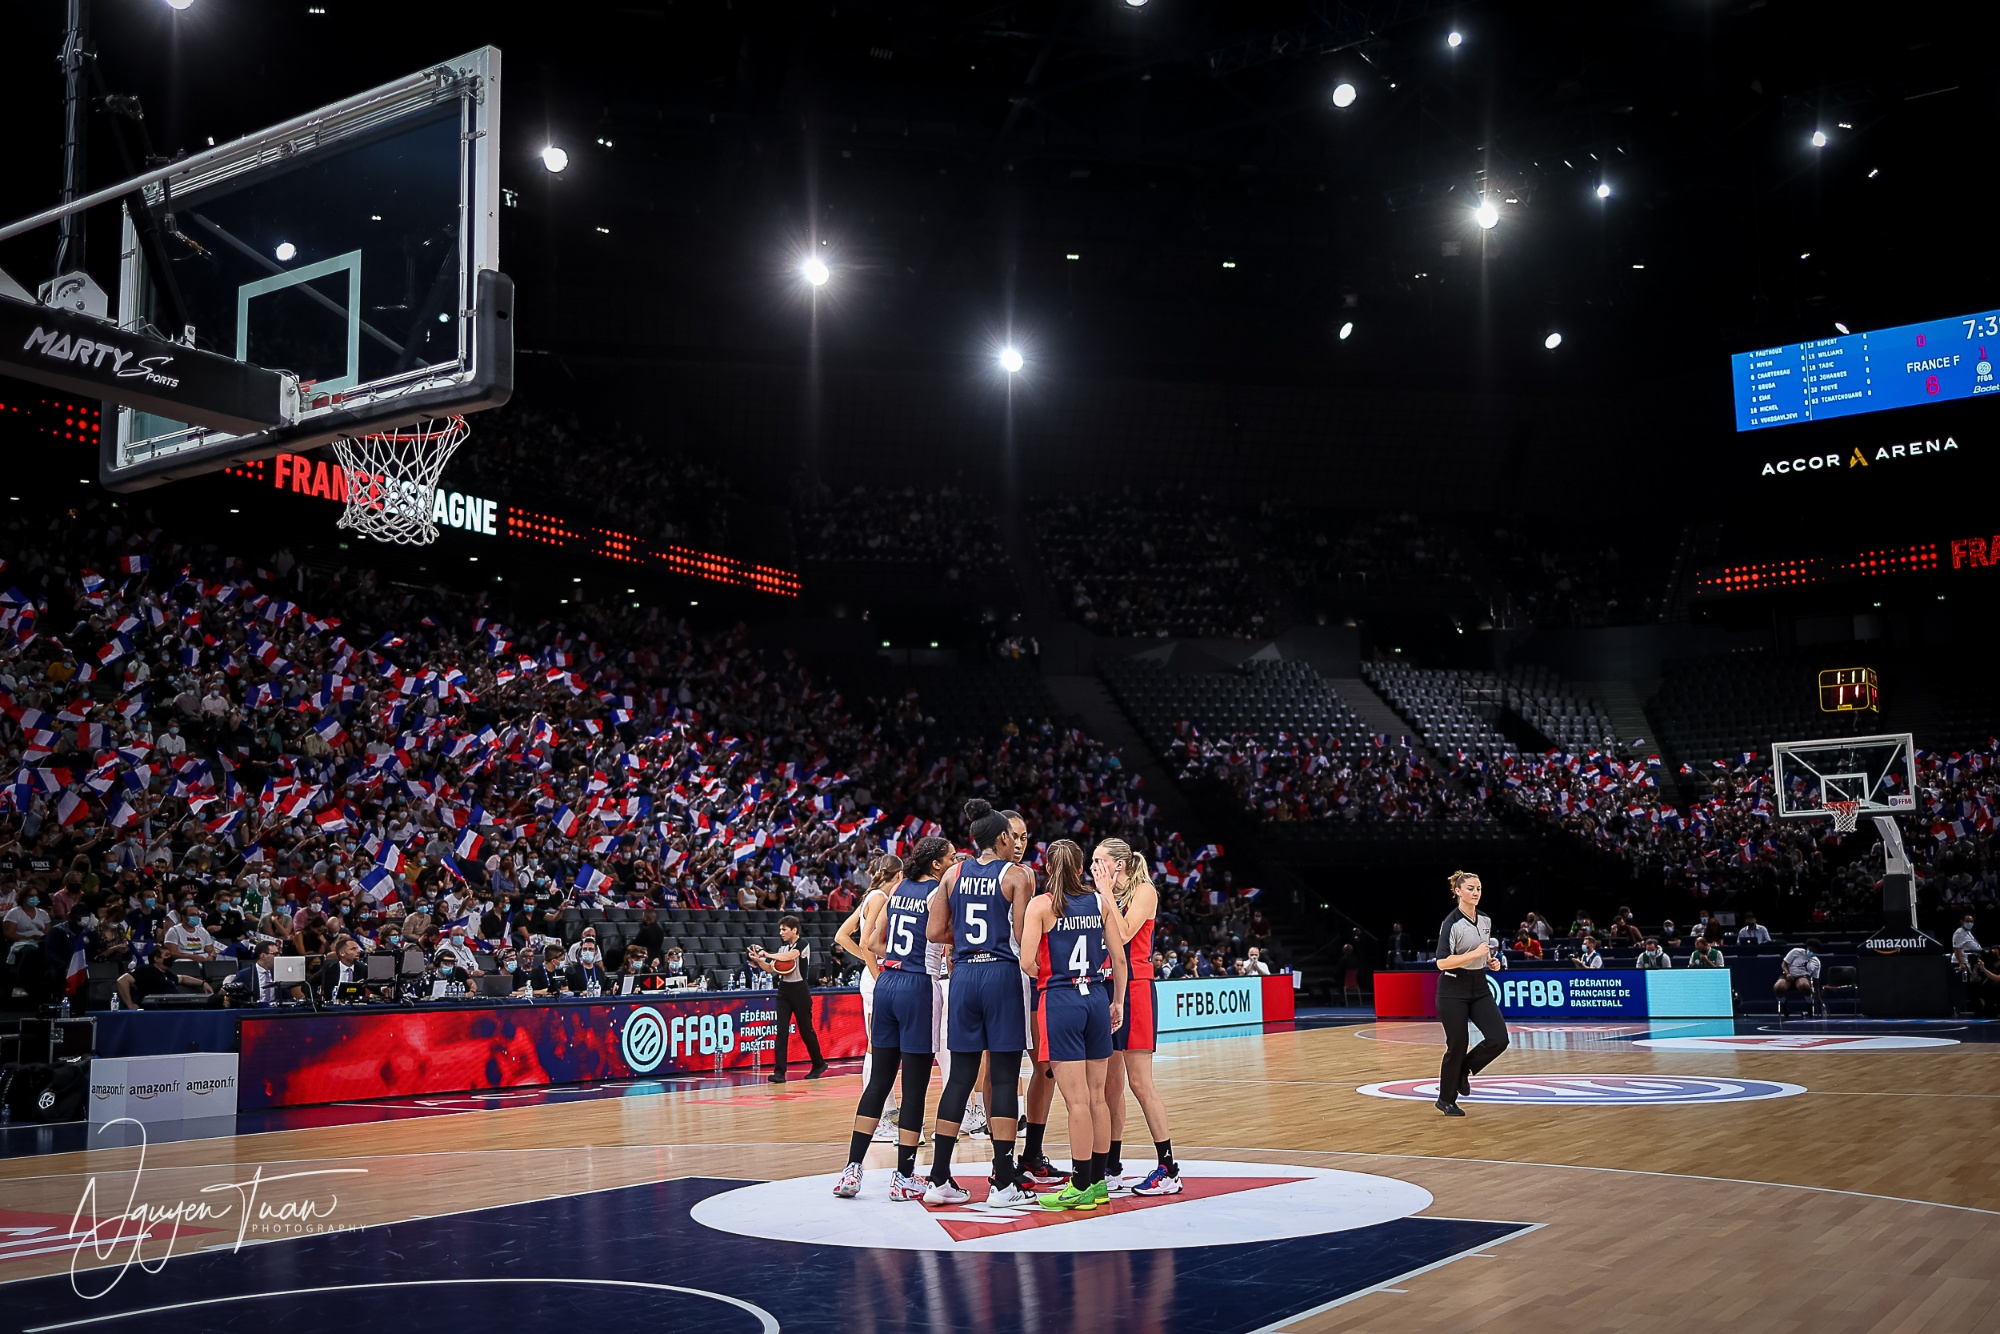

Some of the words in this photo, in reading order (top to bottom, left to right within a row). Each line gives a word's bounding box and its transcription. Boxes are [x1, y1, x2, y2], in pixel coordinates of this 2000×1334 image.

[1916, 334, 1926, 348] 0
[1962, 316, 2000, 340] 7:3
[1817, 338, 1837, 347] RUPERT
[23, 326, 134, 372] MARTY
[117, 356, 180, 388] SPORTS
[1756, 348, 1782, 357] FAUTHOUX
[1818, 348, 1843, 358] WILLIAMS
[1979, 346, 1987, 360] 1
[1907, 357, 1950, 373] FRANCE
[1953, 355, 1960, 366] F
[1757, 369, 1790, 379] CHARTEREAU
[1820, 370, 1847, 380] JOHANNES
[1977, 374, 1993, 382] FFBB
[1821, 383, 1838, 392] POUYE
[1926, 375, 1940, 395] 6
[1821, 391, 1862, 403] TCHATCHOUANG
[1762, 454, 1840, 476] ACCOR
[1875, 437, 1958, 460] ARENA
[275, 453, 384, 510] FRANCE
[960, 877, 996, 895] MIYEM
[891, 896, 927, 913] WILLIAMS
[965, 903, 987, 945] 5
[1057, 915, 1102, 931] FAUTHOUX
[886, 913, 917, 956] 15
[1866, 935, 1928, 948] amazon.fr
[1069, 935, 1090, 976] 4
[1569, 978, 1621, 987] FÉDÉRATION
[1503, 980, 1565, 1007] FFBB
[1570, 990, 1616, 998] FRANÇAISE
[1176, 989, 1251, 1017] FFBB.COM
[740, 1010, 777, 1022] FÉDÉRATI
[670, 1013, 734, 1057] FFBB
[740, 1025, 777, 1037] FRANÇAIS
[789, 1024, 796, 1034] E
[92, 1084, 124, 1095] amazon.fr
[129, 1080, 180, 1095] amazon.fr
[186, 1076, 235, 1091] amazon.fr
